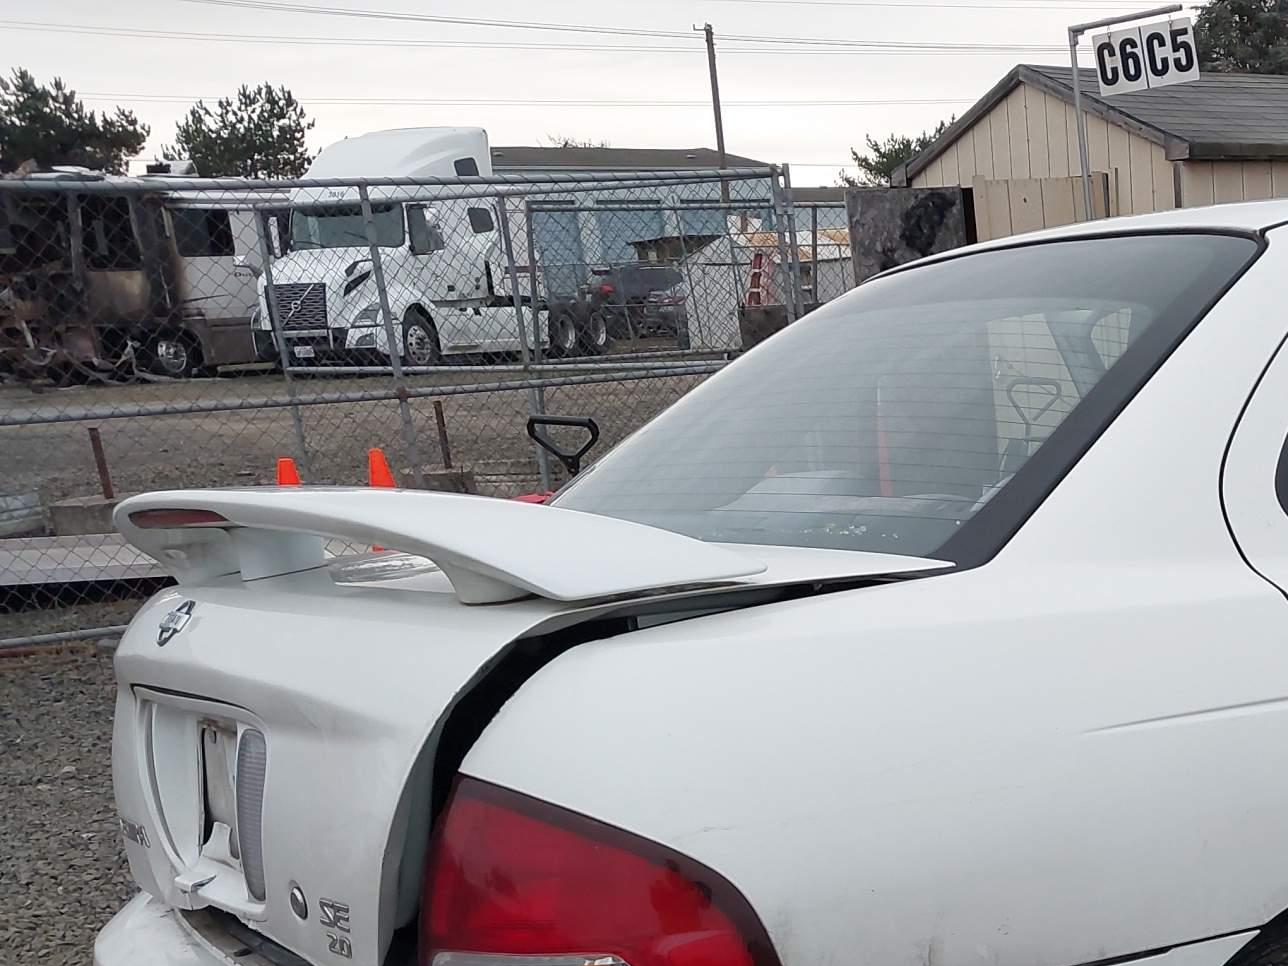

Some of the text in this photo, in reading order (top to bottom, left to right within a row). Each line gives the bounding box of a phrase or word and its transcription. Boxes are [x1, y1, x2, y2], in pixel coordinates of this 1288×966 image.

[1097, 27, 1194, 87] C6 C5
[319, 898, 351, 934] SE
